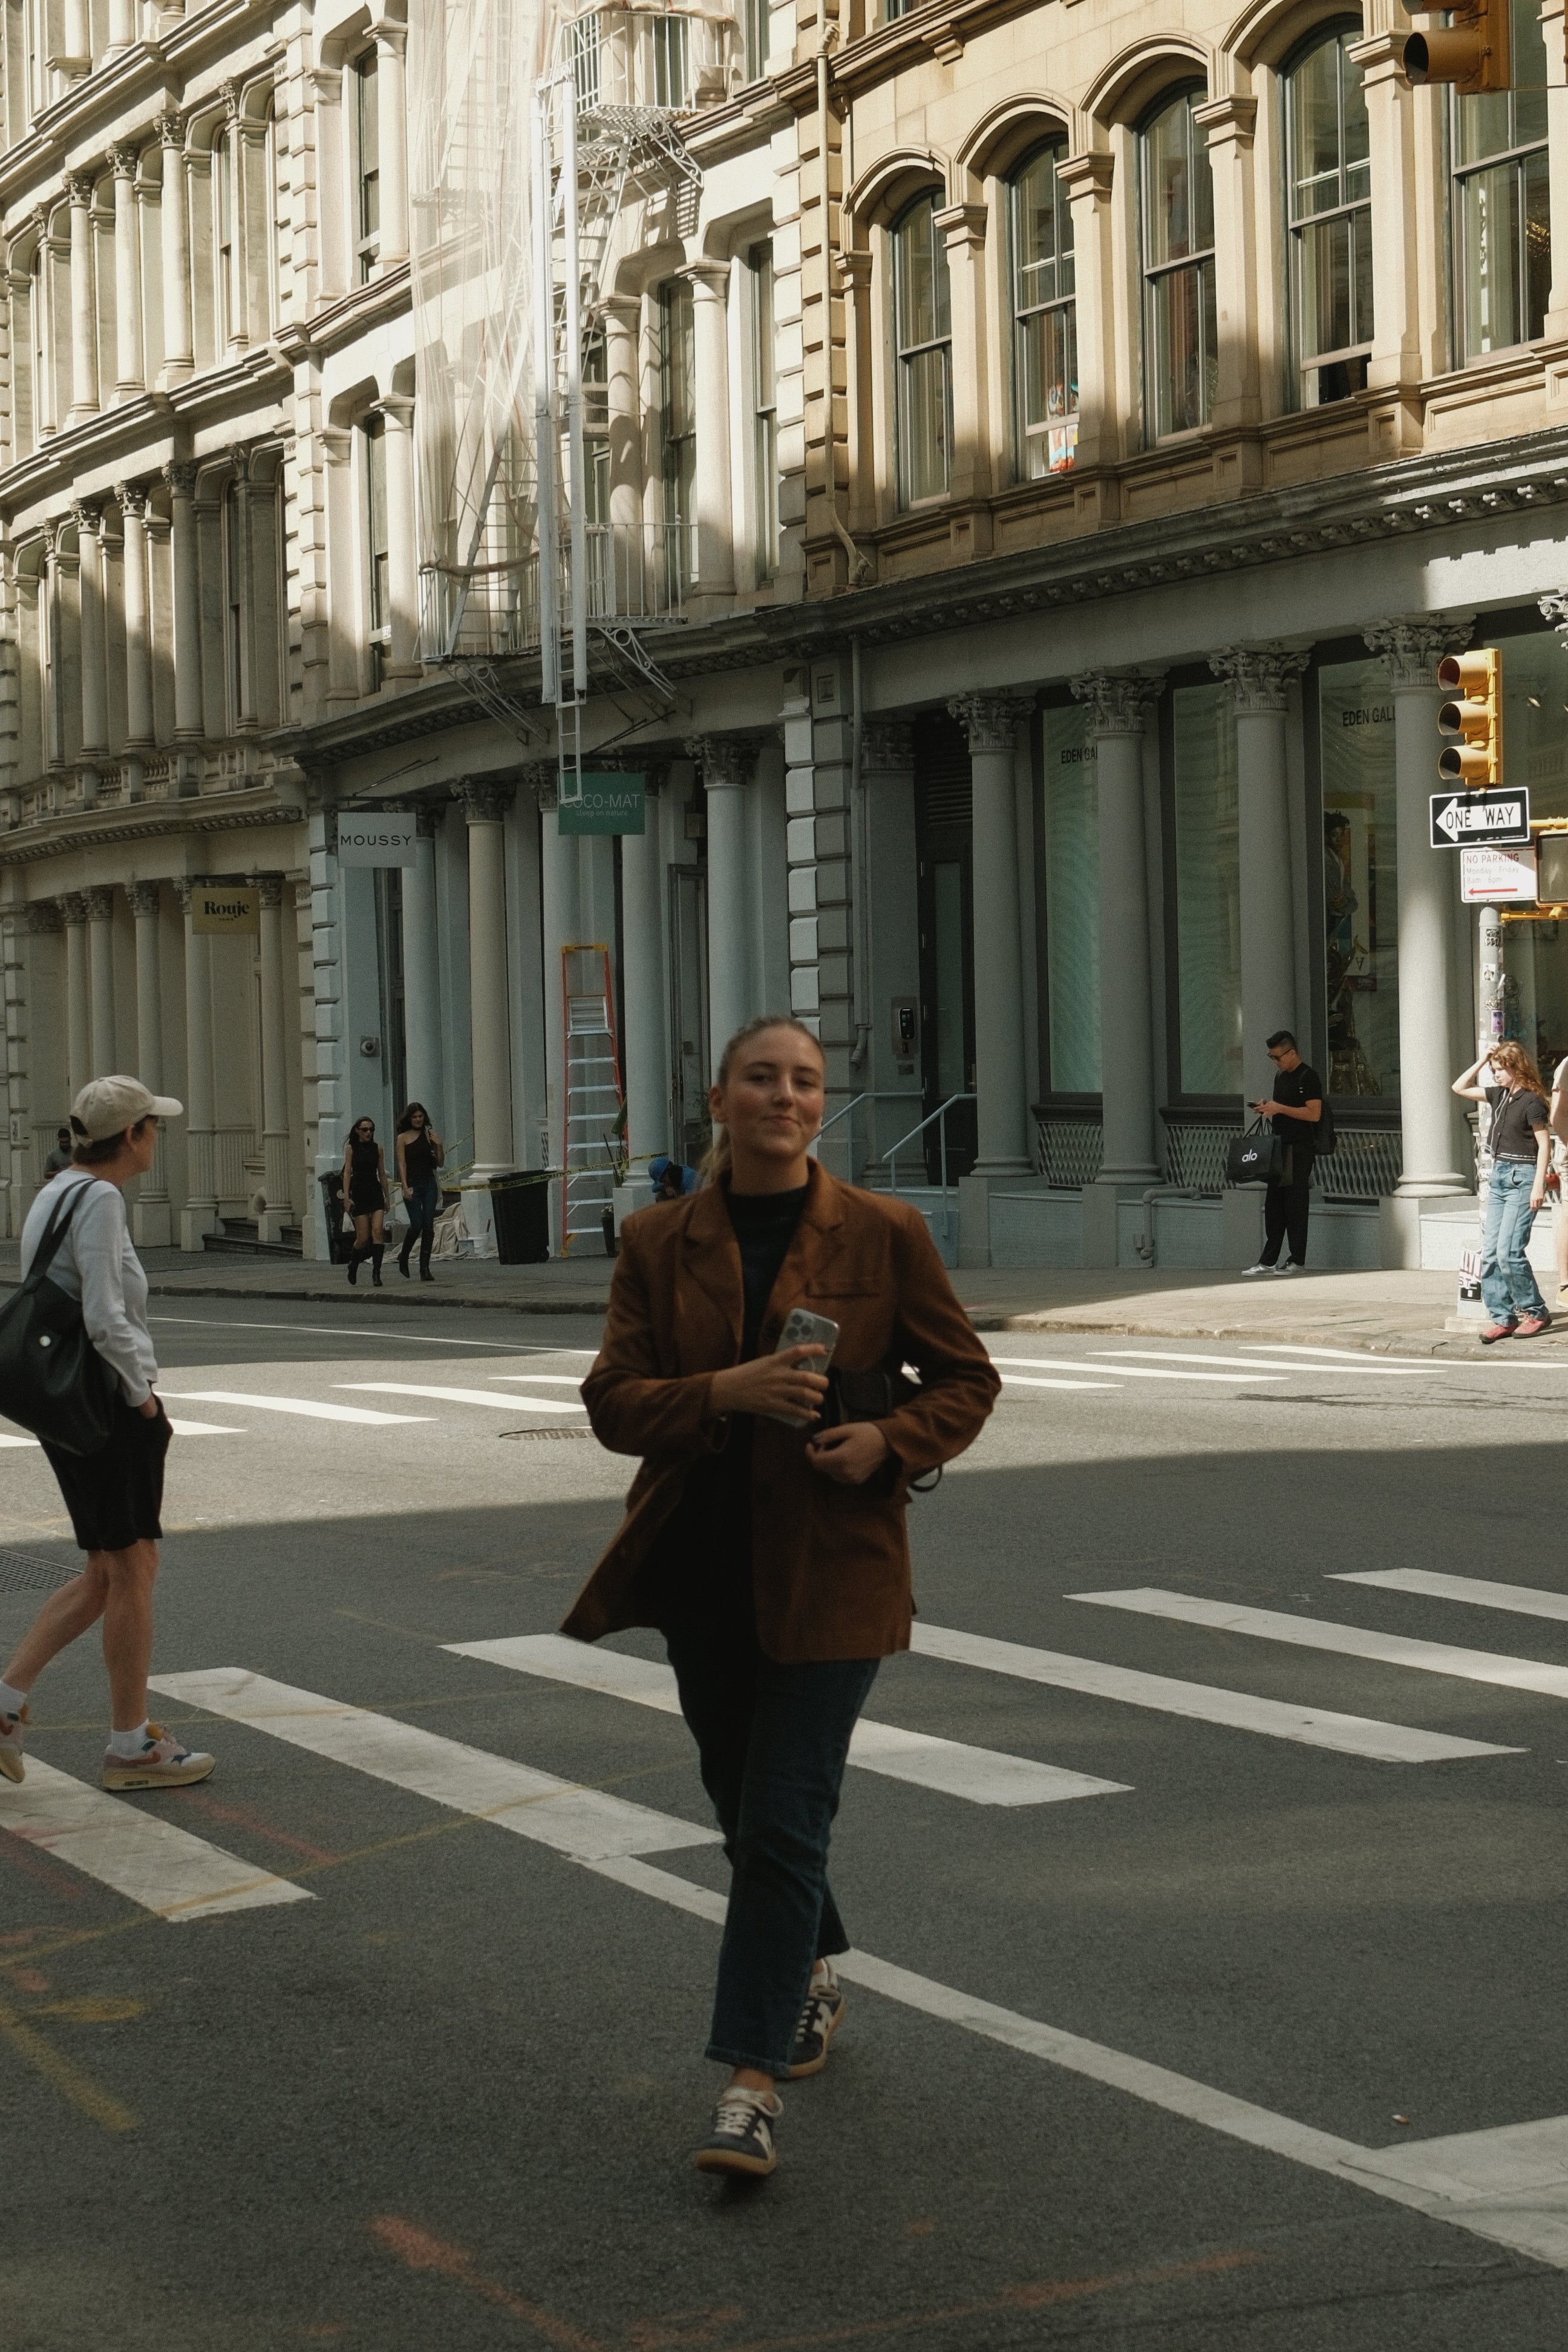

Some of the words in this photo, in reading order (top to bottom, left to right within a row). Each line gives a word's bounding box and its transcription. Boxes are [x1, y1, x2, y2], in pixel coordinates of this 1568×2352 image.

[1342, 708, 1370, 727] EDEN
[1061, 748, 1082, 764] EDEN
[1446, 809, 1472, 829] ONE
[1485, 806, 1514, 826] WAY
[341, 835, 412, 846] MOUSSY
[1466, 855, 1478, 864] NO
[1481, 853, 1520, 863] PARKING
[204, 901, 249, 918] Rouje
[1241, 1149, 1258, 1163] alo
